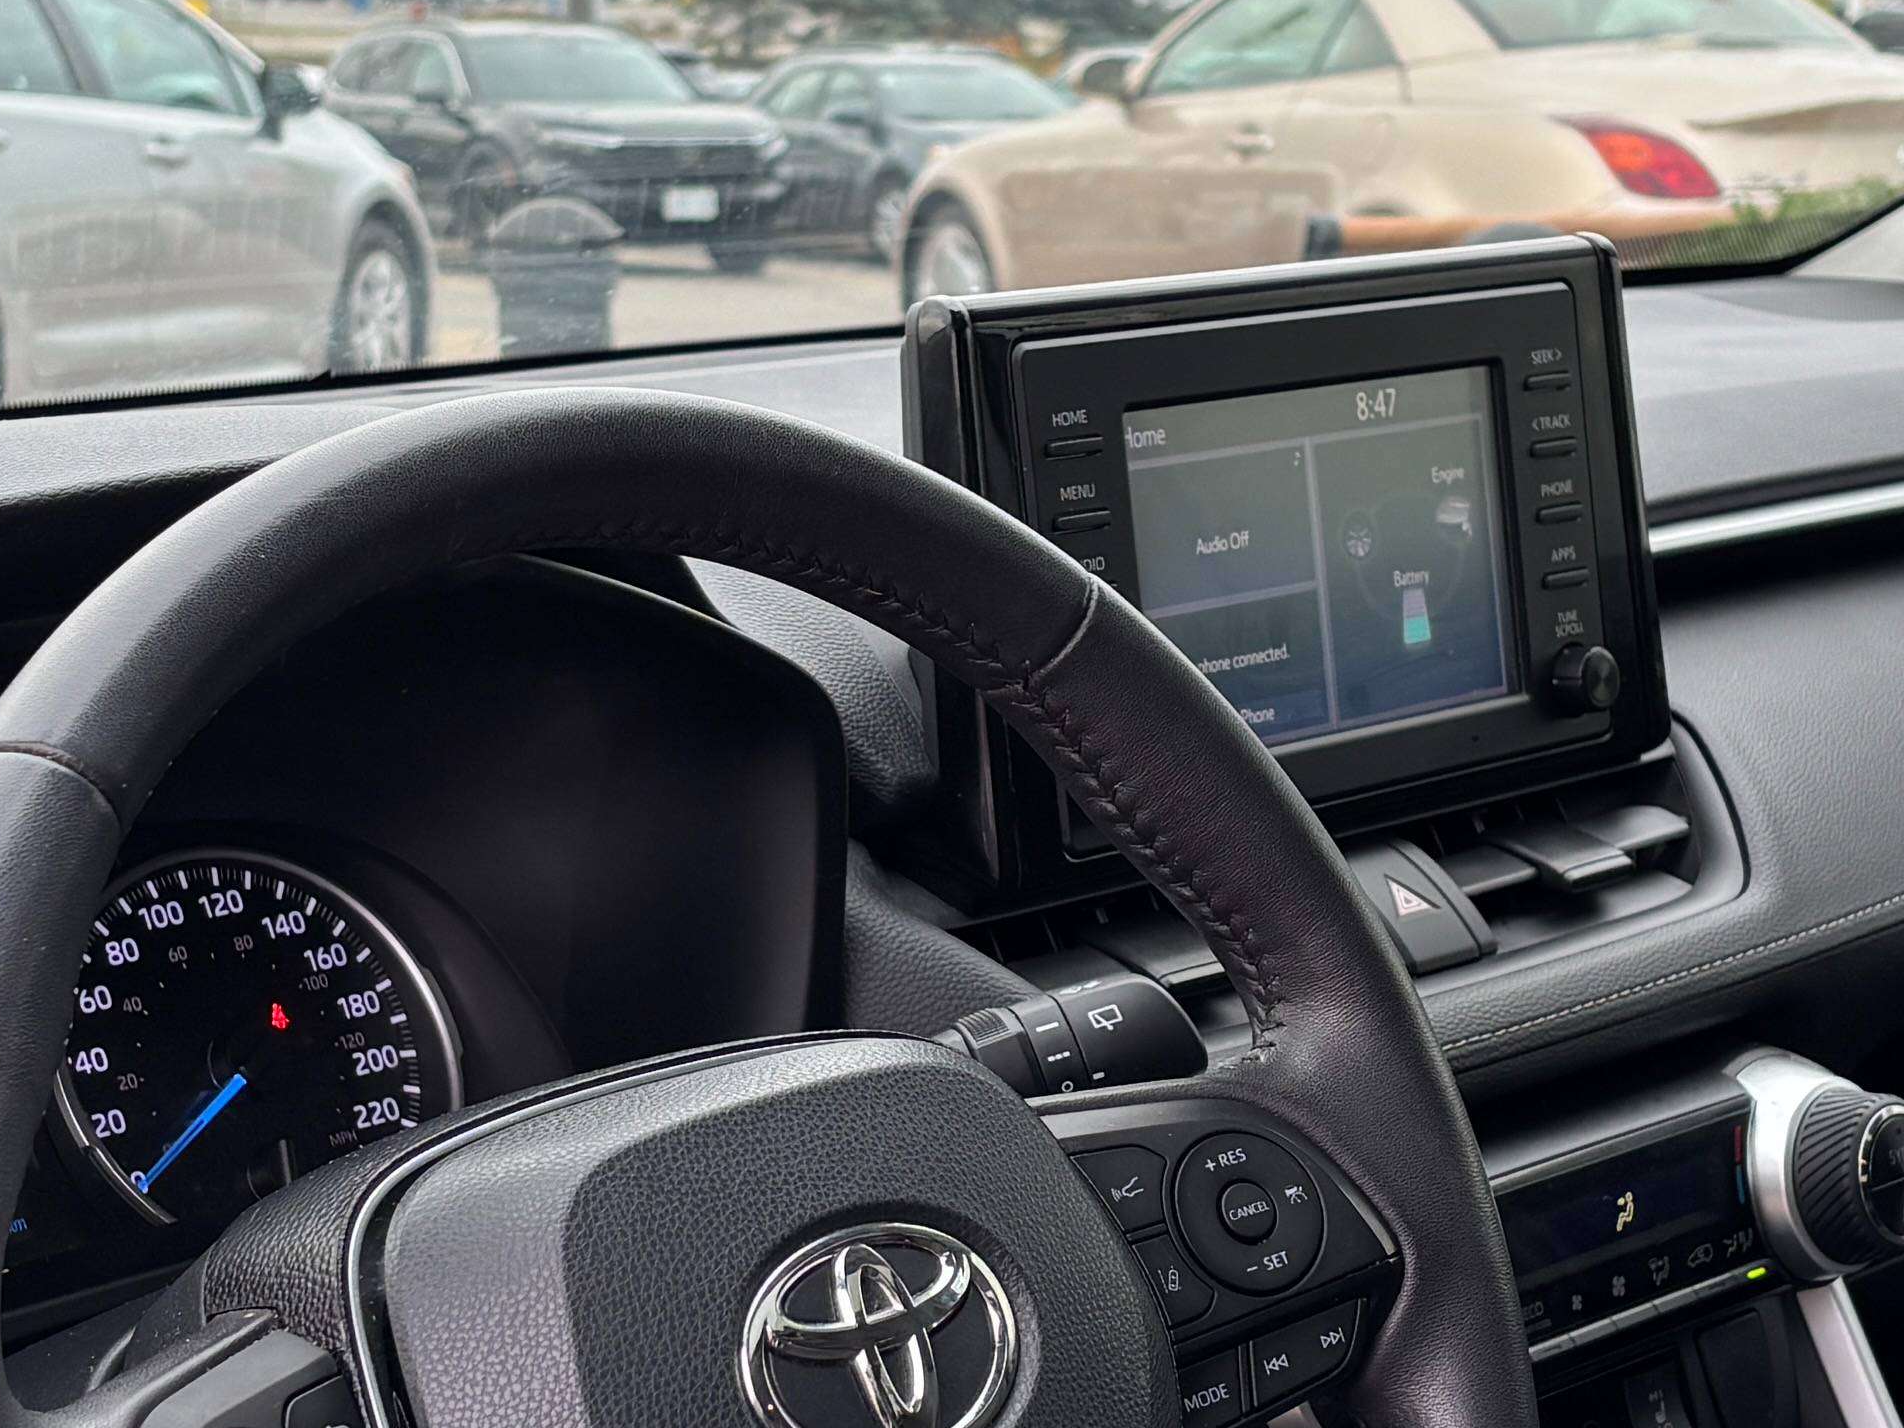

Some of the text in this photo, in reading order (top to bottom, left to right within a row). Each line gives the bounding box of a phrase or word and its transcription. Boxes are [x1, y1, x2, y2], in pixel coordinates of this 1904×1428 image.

[1356, 388, 1396, 420] 8:47
[1052, 409, 1089, 427] HOME
[1431, 466, 1465, 484] Engine
[1059, 483, 1096, 502] MENU
[1541, 479, 1573, 498] PHONE
[1196, 531, 1250, 555] Audio Off
[1551, 545, 1576, 562] APPS
[1393, 570, 1430, 588] Battery
[198, 889, 244, 919] 120
[138, 901, 184, 930] 100
[261, 910, 306, 939] 140
[105, 938, 140, 966] 80
[233, 934, 253, 951] 80
[168, 946, 188, 963] 60
[303, 943, 347, 972] 160
[304, 974, 329, 991] 100
[79, 985, 112, 1013] 60
[123, 996, 142, 1012] 40
[337, 990, 380, 1020] 180
[339, 1032, 365, 1050] 120
[75, 1047, 109, 1074] 40
[352, 1045, 398, 1076] 200
[117, 1073, 138, 1091] 20
[353, 1097, 400, 1129] 220
[91, 1109, 127, 1138] 20
[329, 1129, 358, 1147] MPH
[1229, 1201, 1270, 1220] CANCEL
[1263, 1251, 1288, 1271] SET
[1184, 1383, 1230, 1413] MODE
